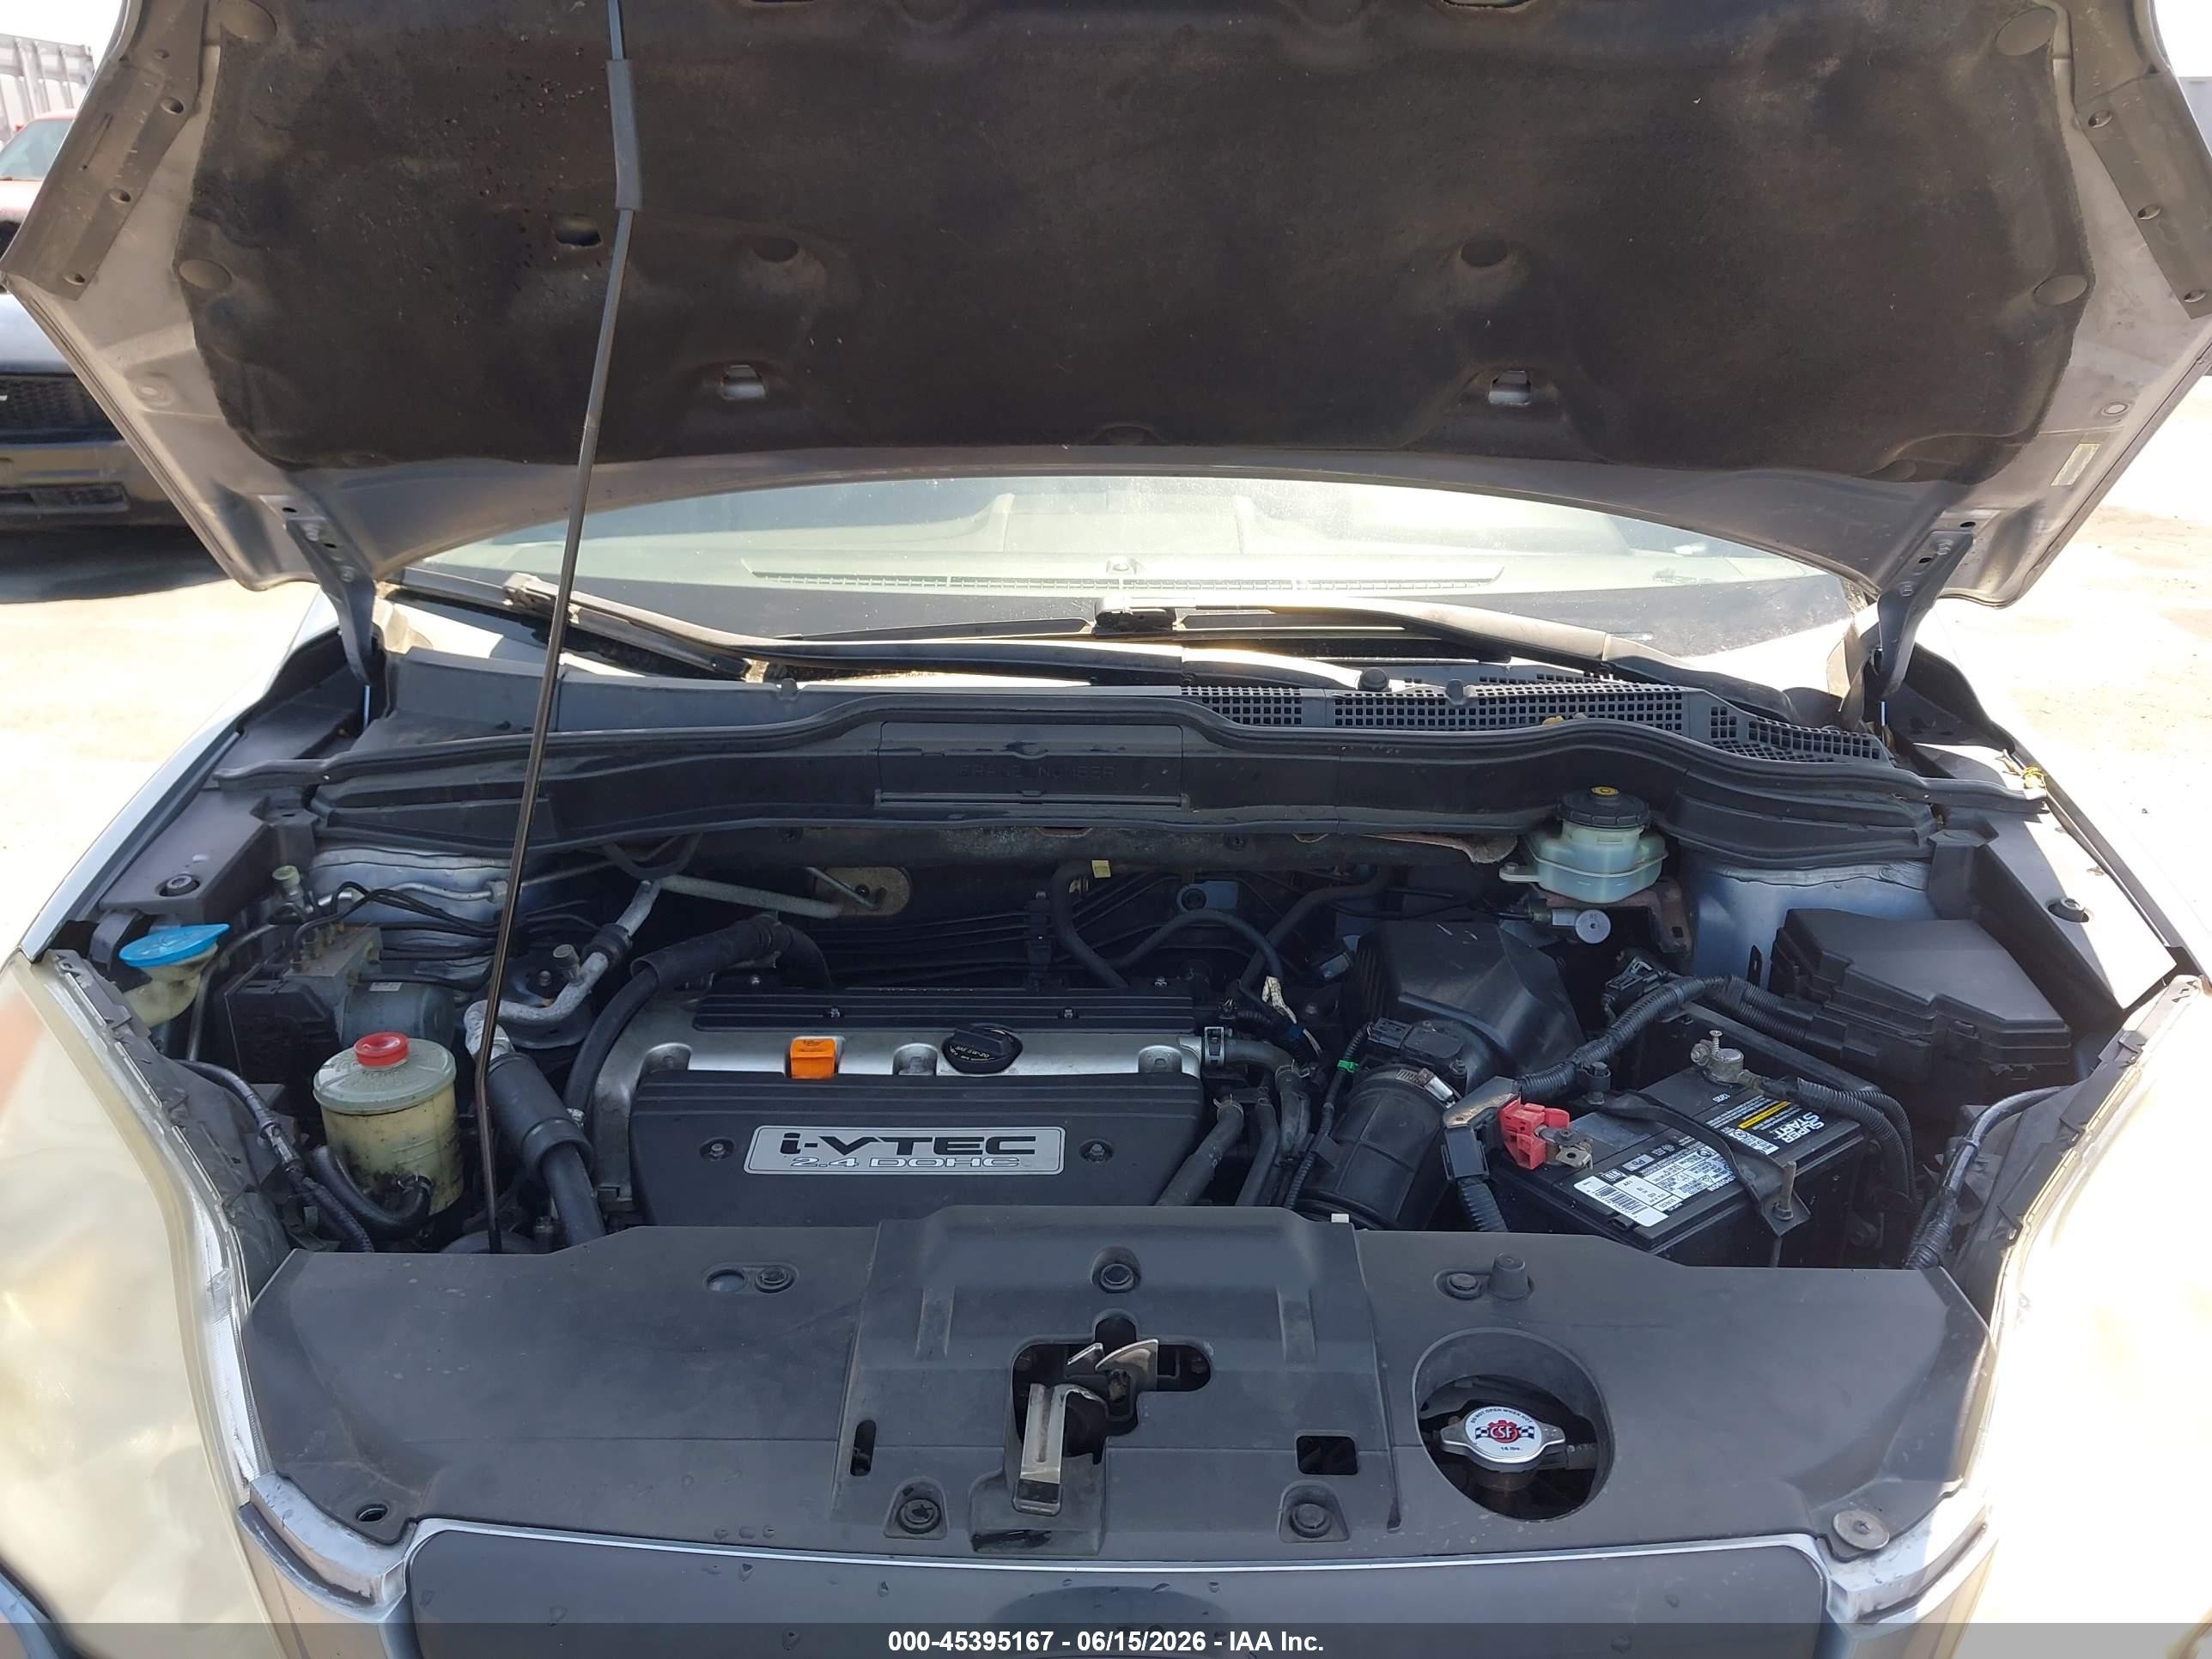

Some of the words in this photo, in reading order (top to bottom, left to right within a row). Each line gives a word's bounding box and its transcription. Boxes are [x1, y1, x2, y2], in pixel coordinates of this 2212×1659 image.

[960, 764, 1024, 778] FRAME
[1038, 765, 1115, 780] NUMBER
[1778, 1111, 1820, 1139] START
[1784, 1118, 1826, 1144] SUPER
[779, 1132, 1036, 1156] i-VTEC
[790, 1156, 860, 1169] 2.4
[869, 1156, 1020, 1169] DOHC
[1632, 1158, 1645, 1167] Pb
[1476, 1410, 1486, 1419] NOT
[1521, 1414, 1534, 1423] HOT
[1489, 1425, 1513, 1439] CSF
